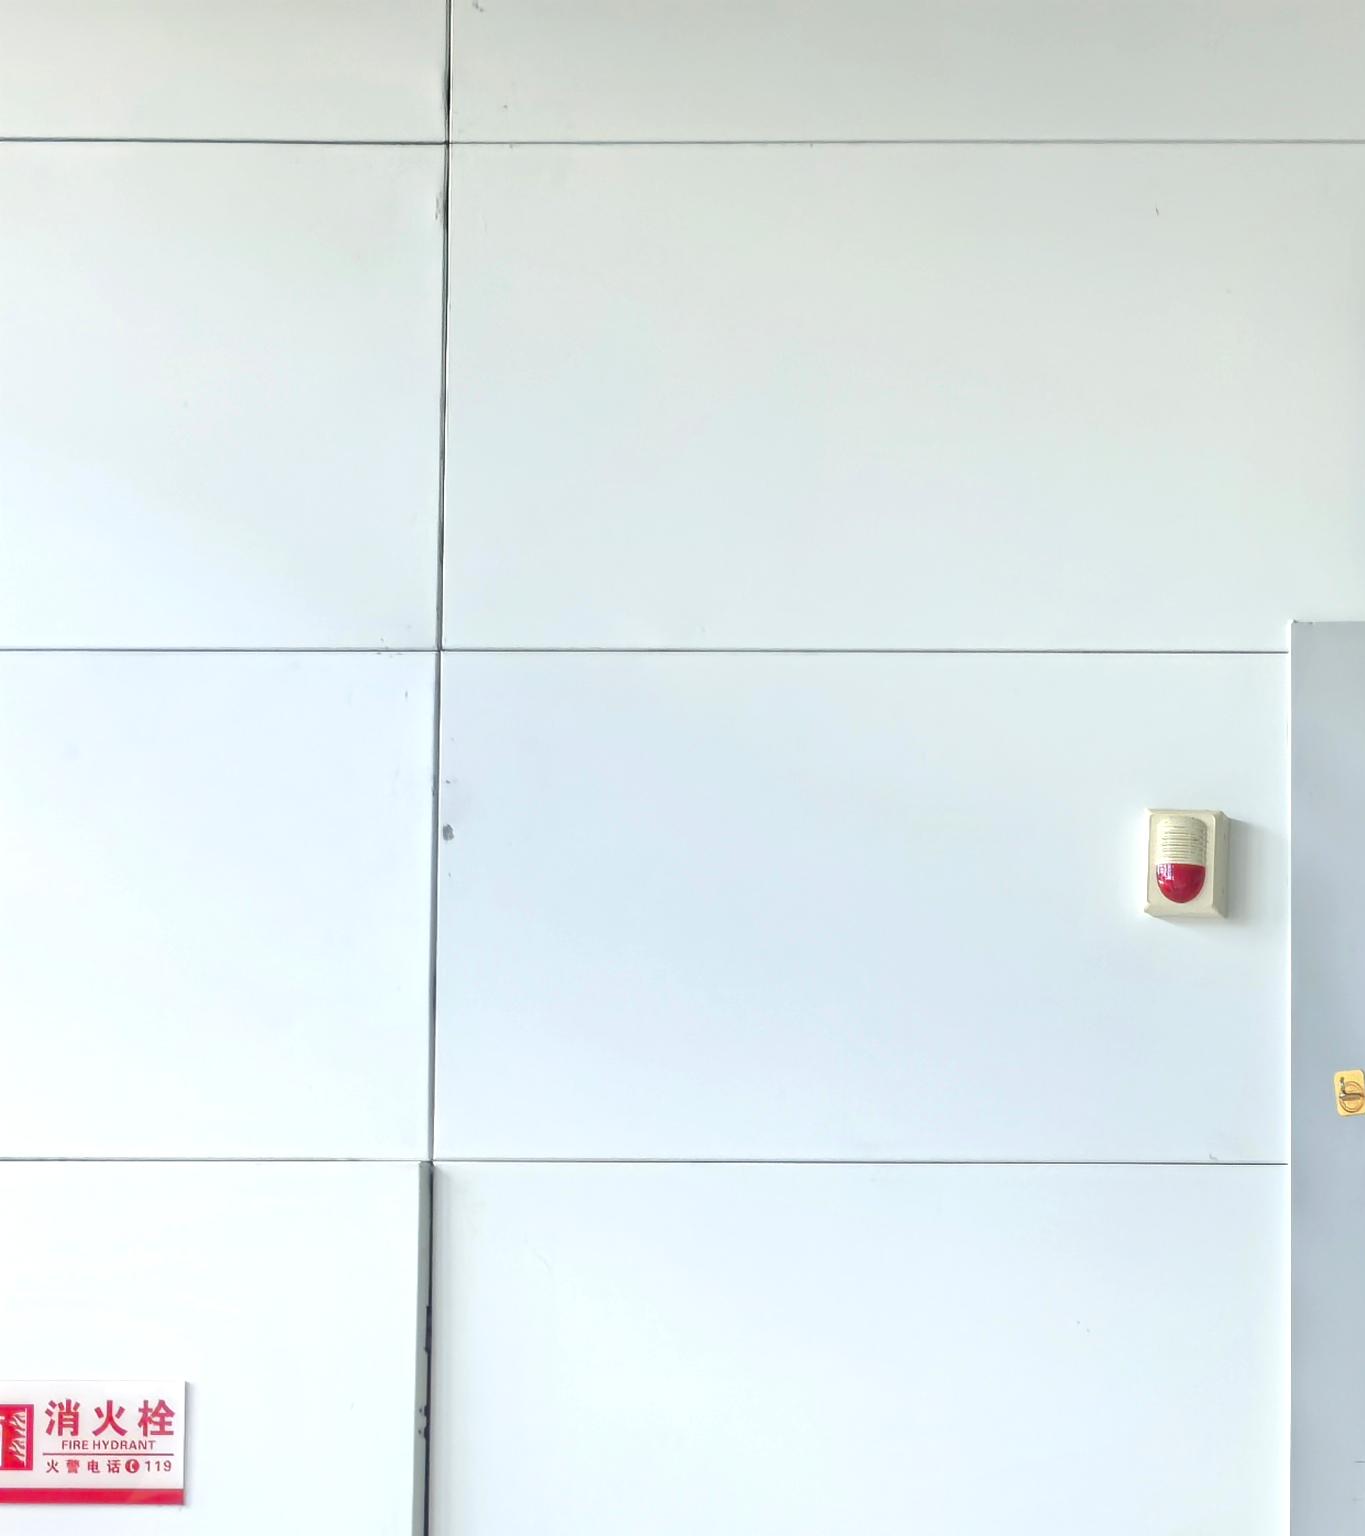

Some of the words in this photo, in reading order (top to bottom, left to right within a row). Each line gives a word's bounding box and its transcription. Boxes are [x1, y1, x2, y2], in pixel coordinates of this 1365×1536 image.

[45, 1399, 175, 1437] 消火栓
[61, 1440, 89, 1450] FIRE
[93, 1440, 156, 1450] HYDRANT
[46, 1459, 121, 1474] 火警电话
[145, 1460, 172, 1472] 119
